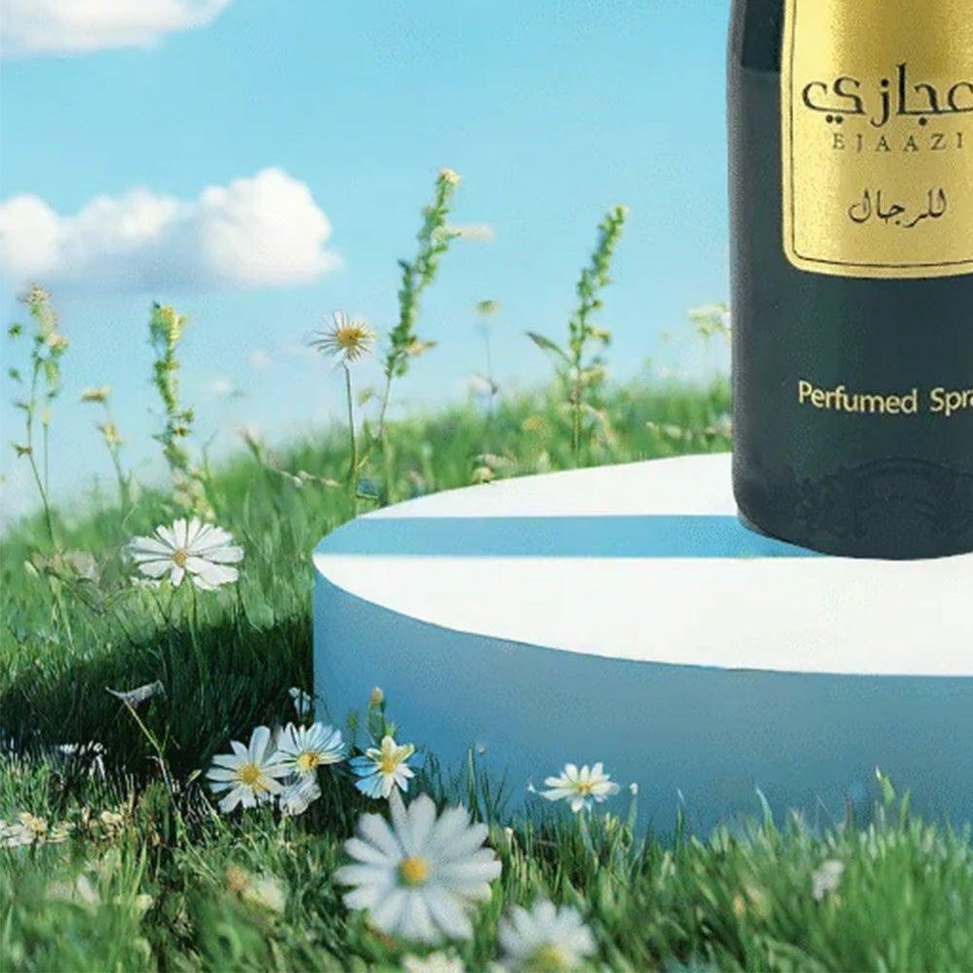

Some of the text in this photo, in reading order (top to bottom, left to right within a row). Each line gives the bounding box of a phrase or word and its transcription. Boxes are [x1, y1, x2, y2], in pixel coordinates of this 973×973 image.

[833, 132, 964, 153] EJAAZI
[847, 187, 947, 227] للرجال
[798, 379, 918, 415] Perfumed
